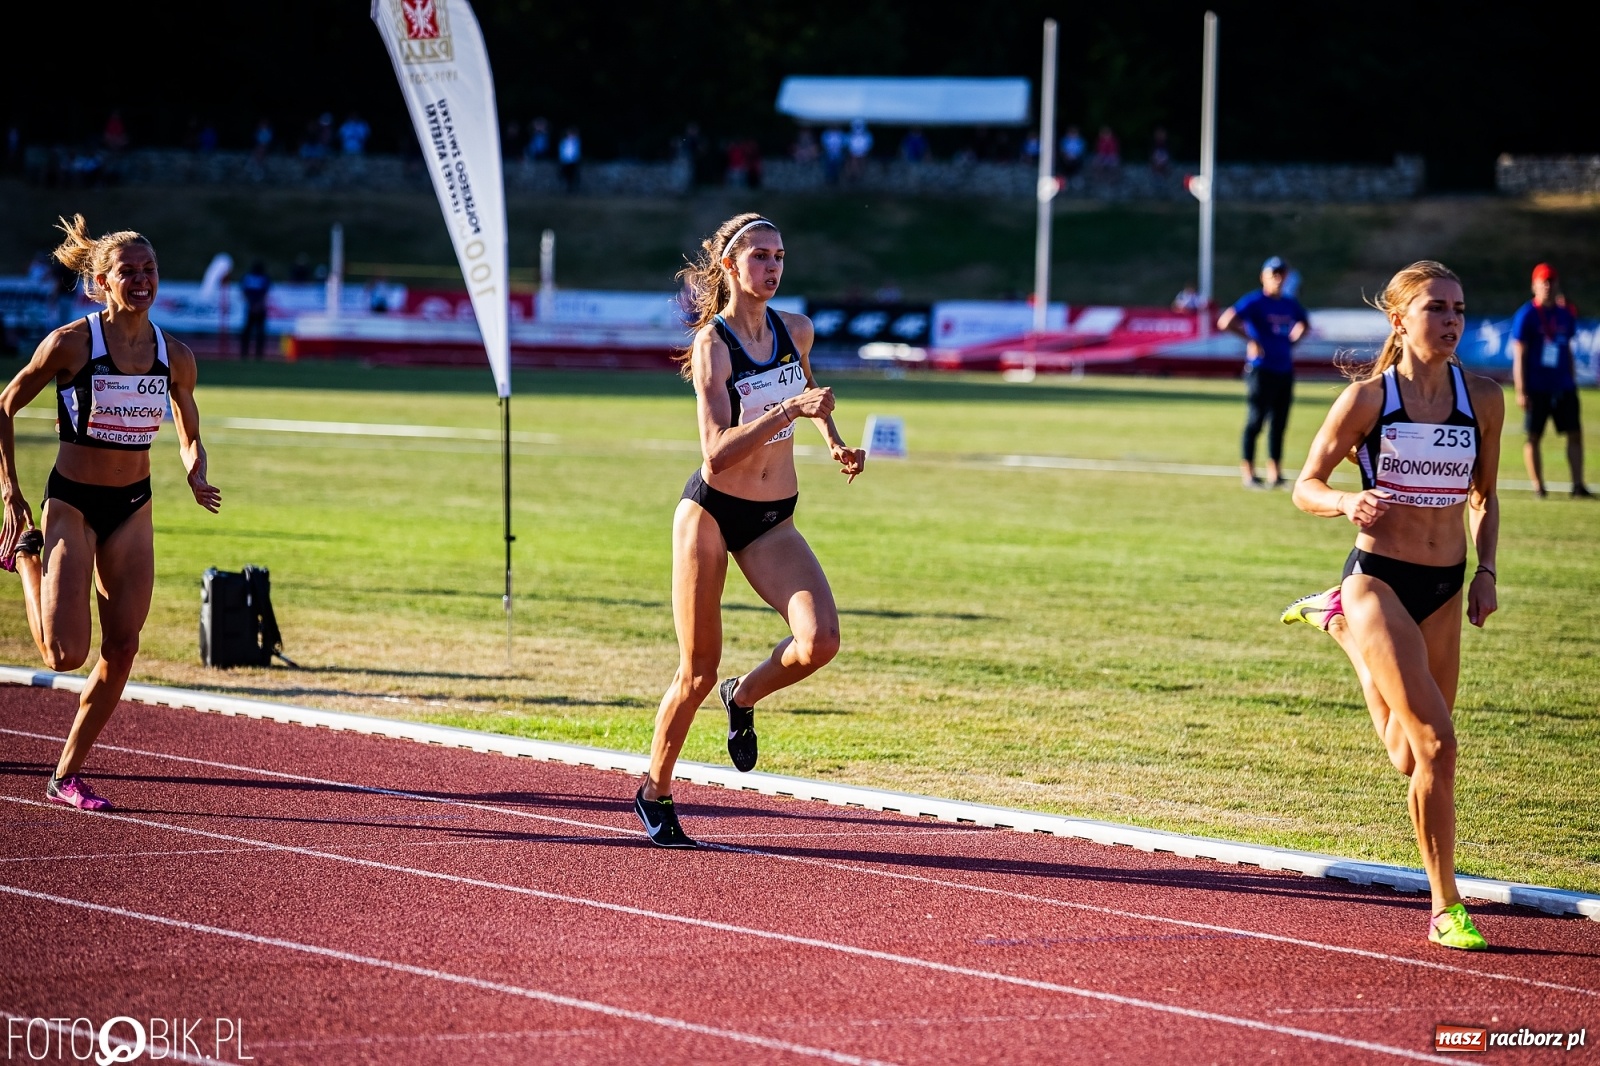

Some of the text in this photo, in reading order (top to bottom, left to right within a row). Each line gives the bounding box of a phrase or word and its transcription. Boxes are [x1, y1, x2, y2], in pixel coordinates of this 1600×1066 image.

[778, 365, 802, 386] 470
[137, 378, 165, 395] 662
[96, 431, 136, 442] RACIBÓRZ
[1433, 428, 1471, 448] 253
[1382, 457, 1469, 477] BRONOWSKA
[1386, 492, 1457, 505] ACIBÓRZ 2019
